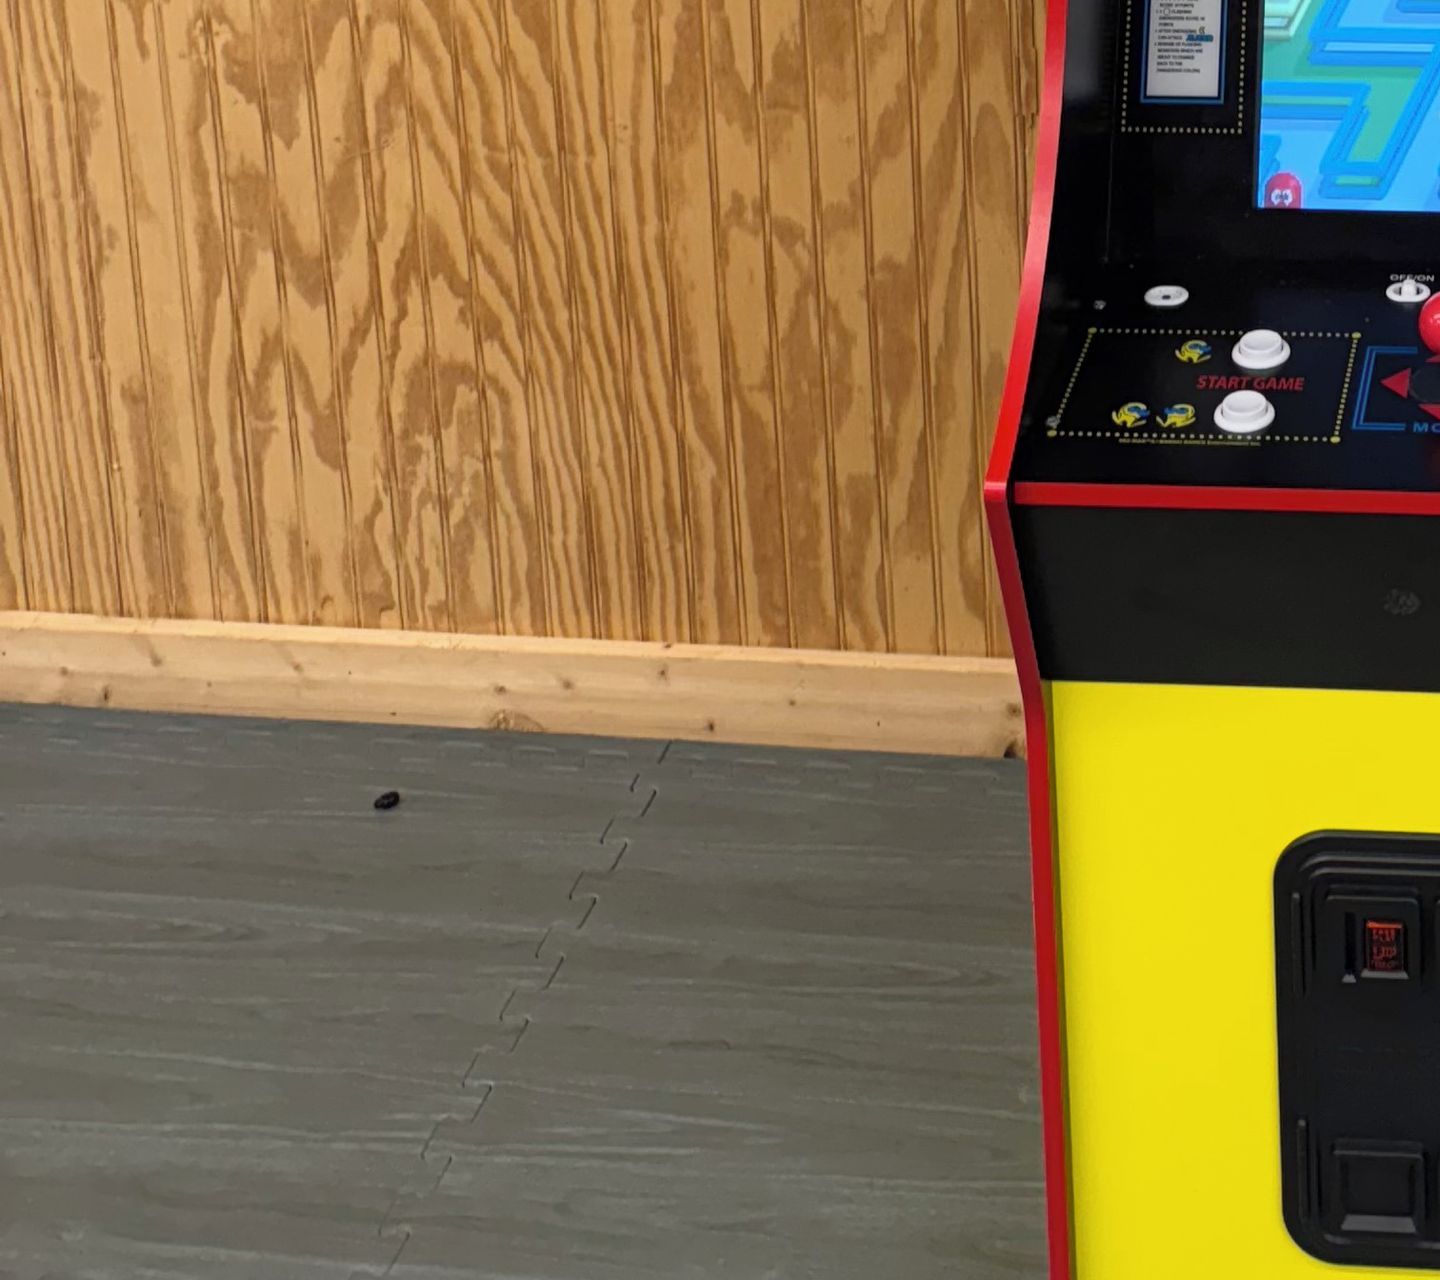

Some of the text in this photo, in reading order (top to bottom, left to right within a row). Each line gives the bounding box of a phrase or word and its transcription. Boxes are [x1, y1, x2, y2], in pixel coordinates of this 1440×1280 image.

[1389, 273, 1435, 282] OFF/ON
[1196, 375, 1305, 391] START GAME
